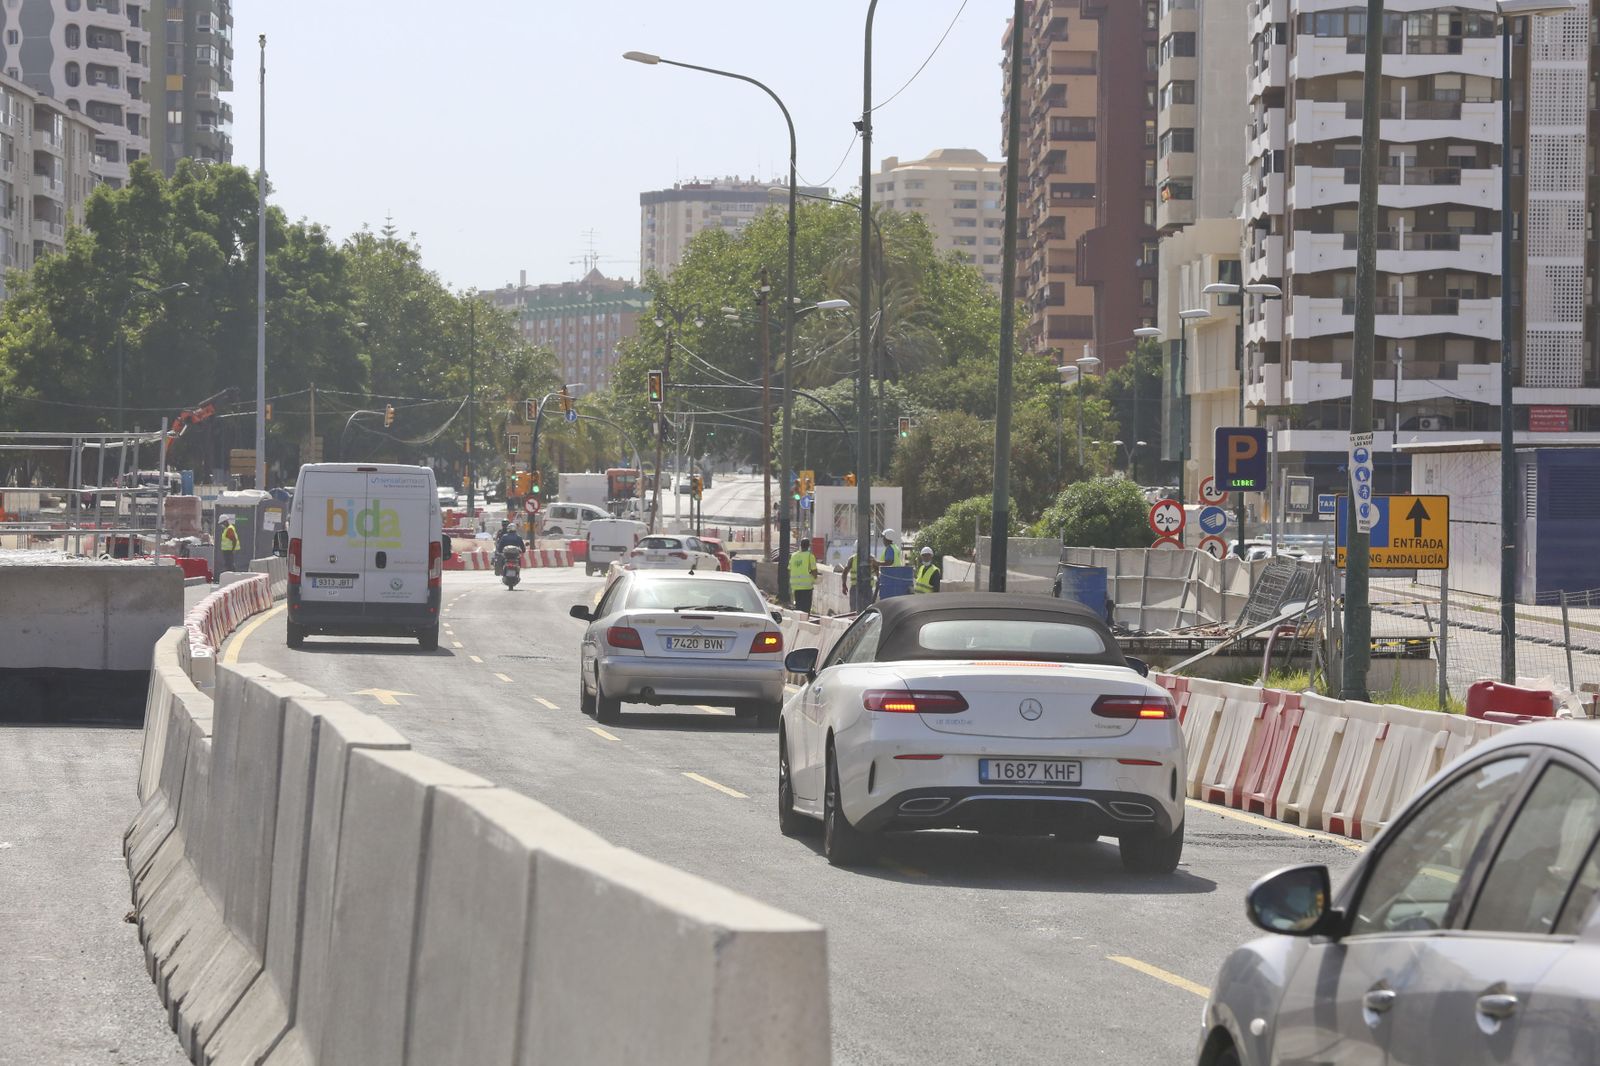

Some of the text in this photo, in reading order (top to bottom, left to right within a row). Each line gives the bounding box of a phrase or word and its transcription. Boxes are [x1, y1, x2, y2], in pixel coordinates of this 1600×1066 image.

[1228, 435, 1258, 474] P
[326, 499, 400, 537] bida
[1393, 538, 1444, 549] ENTRADA
[1386, 553, 1444, 564] ANDALUCÍA
[672, 638, 723, 649] 7420 BVN
[995, 763, 1077, 780] 1687 KHF
